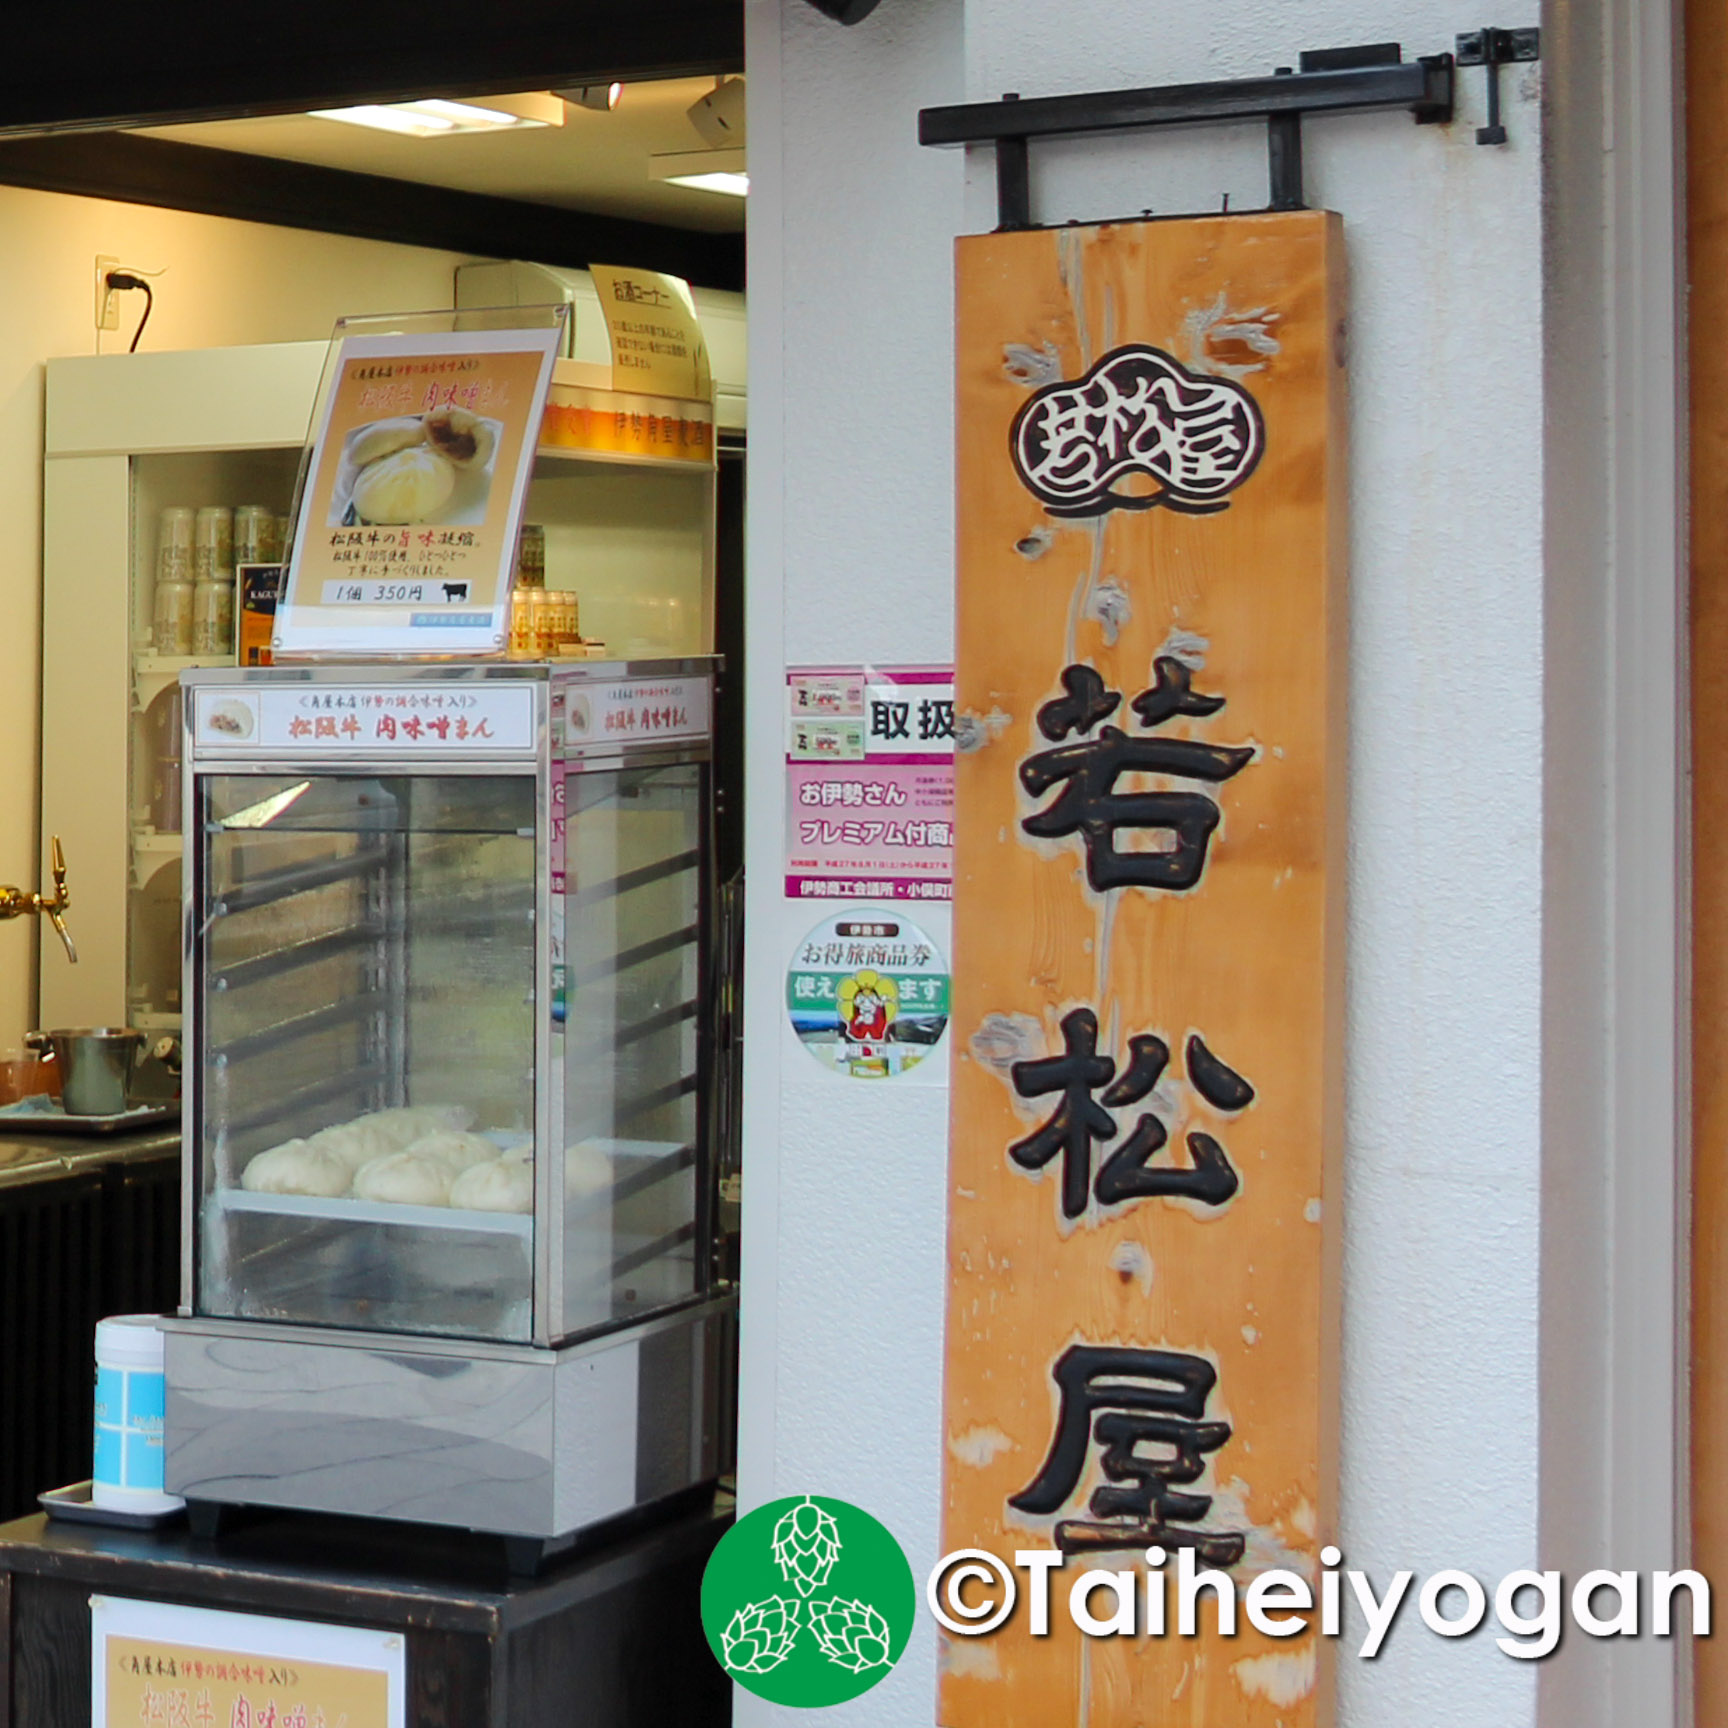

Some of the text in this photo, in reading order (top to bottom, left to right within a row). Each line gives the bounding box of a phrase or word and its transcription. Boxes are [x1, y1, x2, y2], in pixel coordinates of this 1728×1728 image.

[374, 585, 423, 601] 350円
[871, 699, 955, 741] 取扱
[800, 780, 907, 806] お伊勢さん
[800, 819, 954, 847] プレミアム付商
[800, 880, 954, 897] 伊勢商工会議所・小俣町
[802, 943, 931, 967] お得旅商品券
[1007, 658, 1259, 1569] 若松屋
